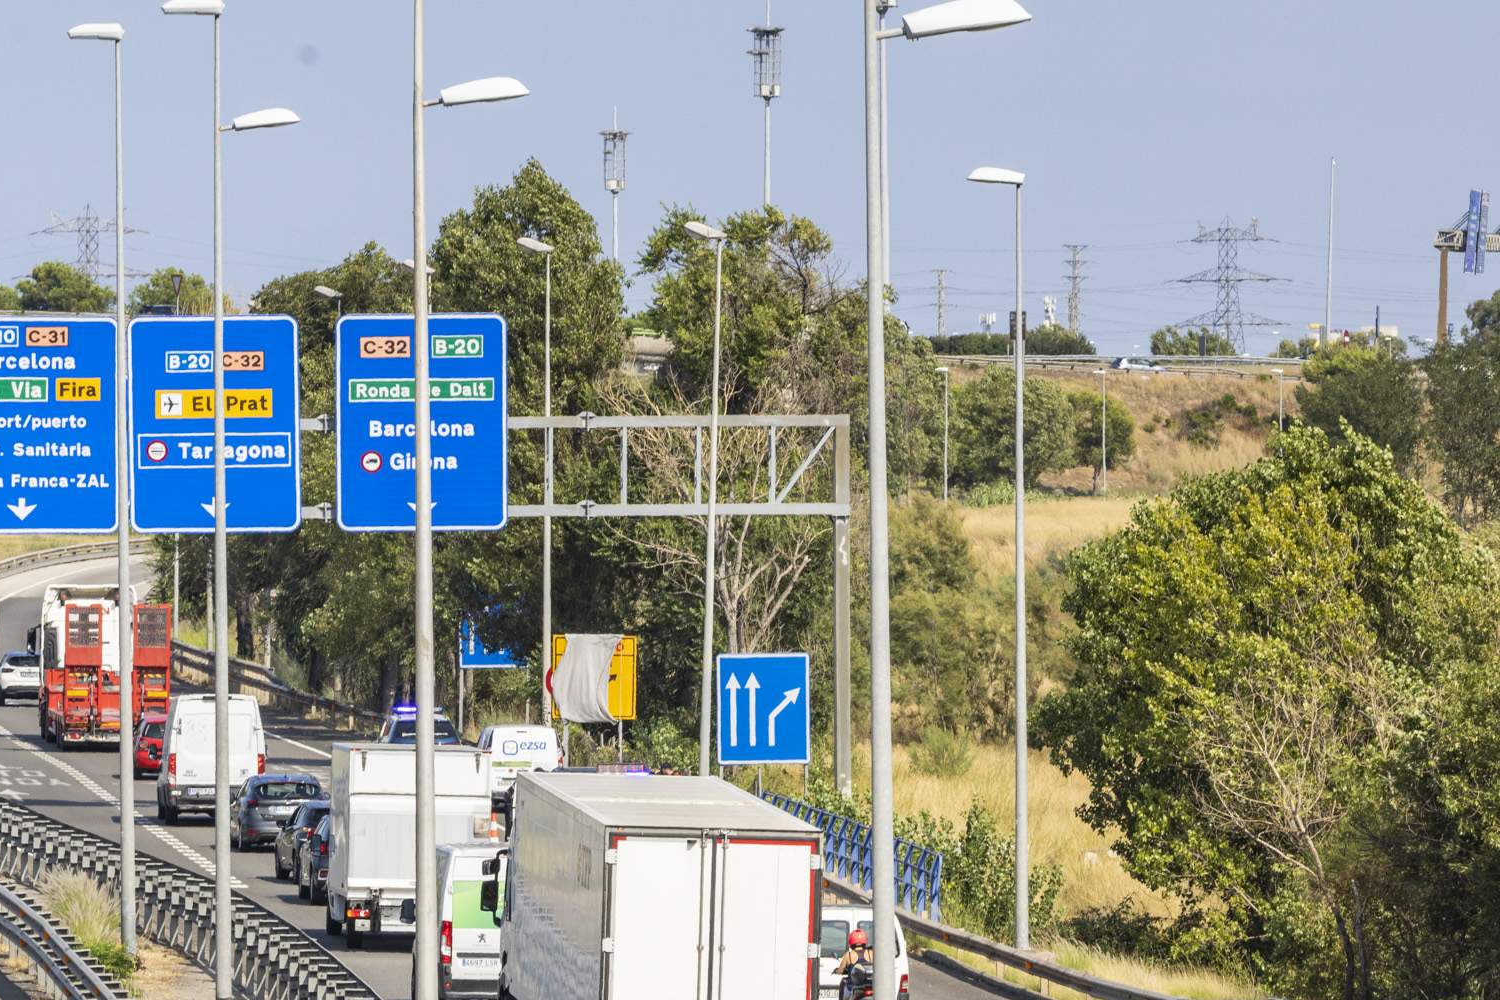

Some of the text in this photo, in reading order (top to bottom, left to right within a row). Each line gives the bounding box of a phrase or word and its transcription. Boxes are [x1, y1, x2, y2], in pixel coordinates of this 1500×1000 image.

[28, 330, 66, 343] C-31
[363, 339, 480, 354] C-32 B-20
[169, 354, 261, 369] B-20 C-32
[12, 382, 42, 398] Via
[59, 383, 96, 397] Fira
[356, 383, 410, 398] Ronda
[450, 382, 486, 397] Dalt
[192, 395, 267, 412] El Prat
[369, 420, 474, 438] Barclona
[13, 443, 91, 457] Sanitària
[178, 442, 286, 461] Taragona
[389, 453, 458, 470] Girna
[11, 474, 109, 488] Franca-ZAL
[520, 741, 547, 750] ezsa
